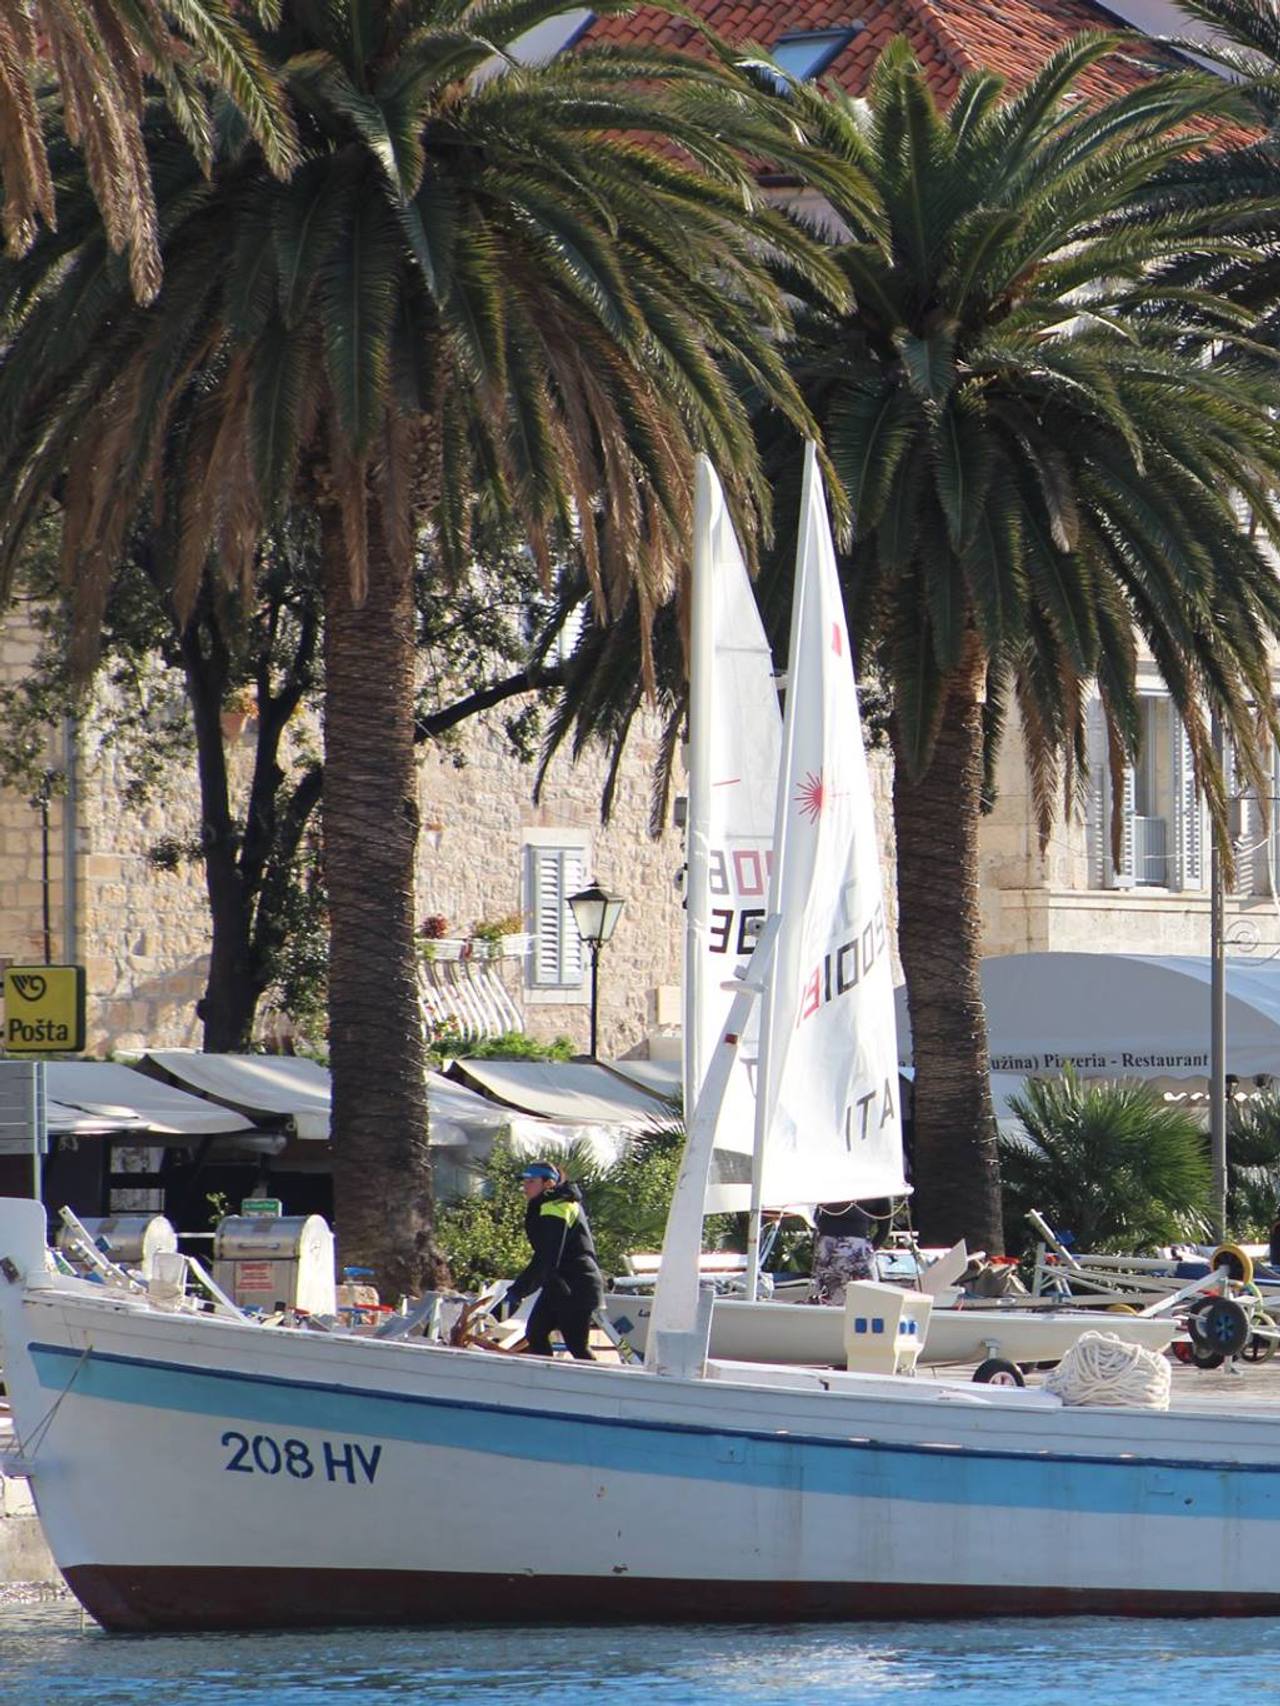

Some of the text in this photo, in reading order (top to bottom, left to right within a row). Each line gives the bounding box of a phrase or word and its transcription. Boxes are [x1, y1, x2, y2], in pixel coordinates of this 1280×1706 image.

[9, 1018, 69, 1042] Pošta
[1122, 1052, 1208, 1068] Restaurant
[845, 1078, 895, 1152] ITA
[221, 1431, 383, 1484] 208 HV
